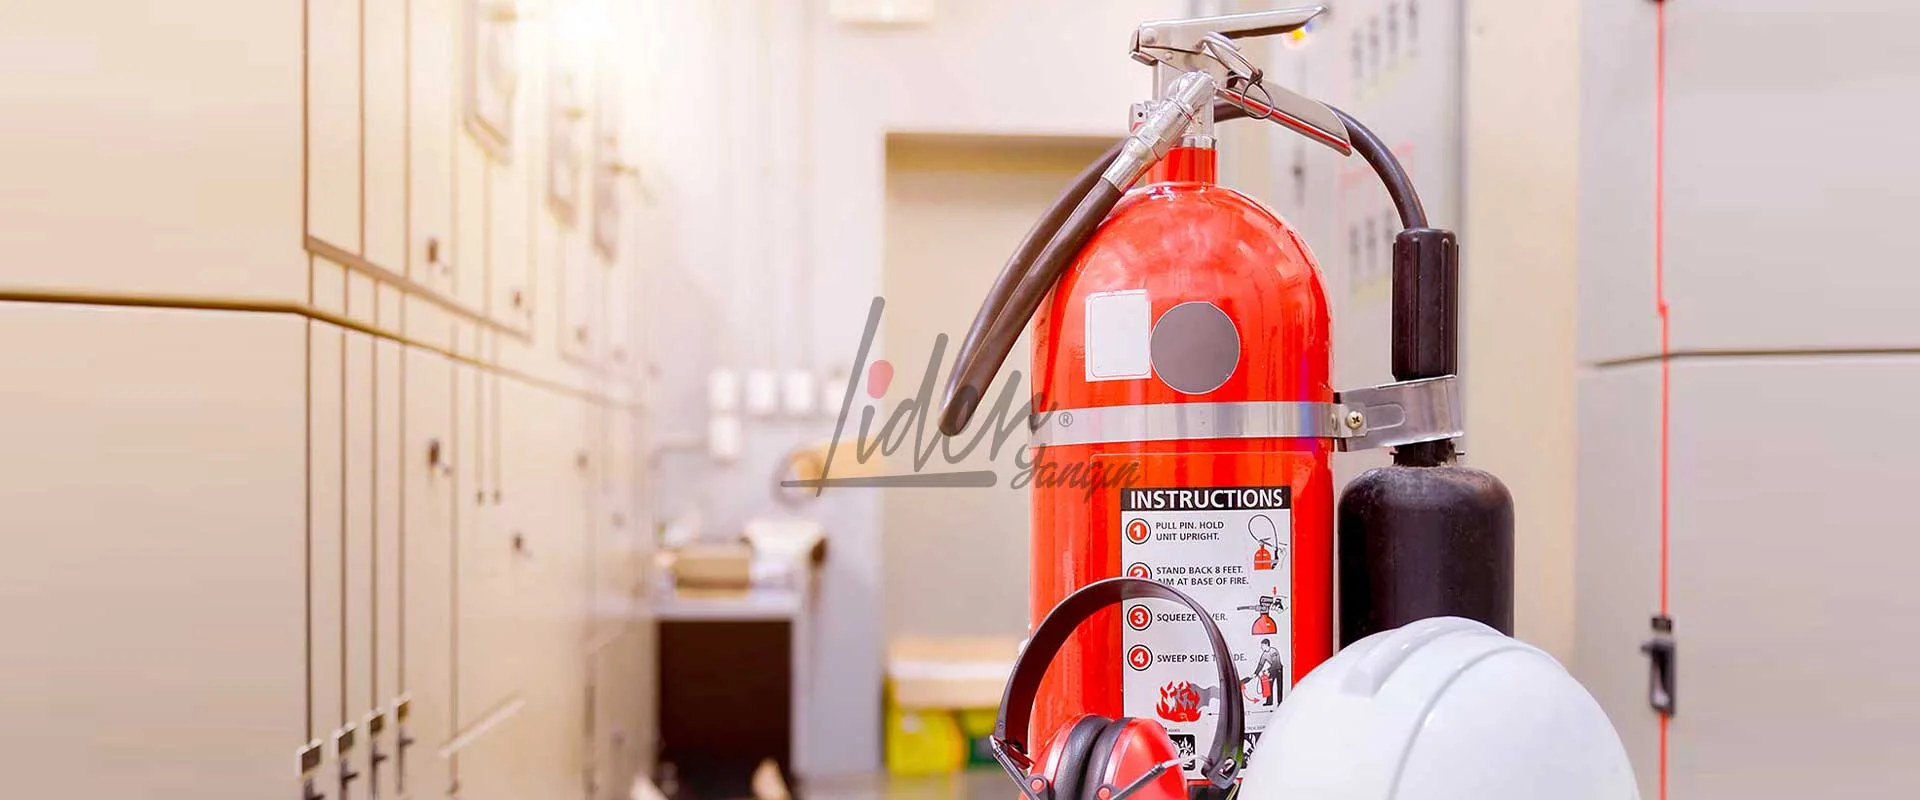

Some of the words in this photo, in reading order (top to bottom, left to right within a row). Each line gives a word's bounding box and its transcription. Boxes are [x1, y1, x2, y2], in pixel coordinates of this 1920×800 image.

[1130, 488, 1283, 509] INSTRUCTIONS
[1155, 521, 1178, 530] PULL
[1179, 521, 1197, 530] PIN.
[1199, 521, 1225, 530] HOLD
[1156, 533, 1177, 541] UNIT
[1179, 532, 1220, 541] UPRIGHT.
[1156, 566, 1186, 575] STAND
[1188, 566, 1213, 575] BACK
[1214, 566, 1221, 574] 8
[1222, 565, 1244, 574] FEET.
[1176, 577, 1189, 586] AT
[1191, 577, 1214, 586] BASE
[1215, 577, 1228, 586] OF
[1229, 576, 1249, 585] FIRE.
[1156, 613, 1197, 622] SQUEEZE
[1156, 654, 1188, 663] SWEEP
[1189, 654, 1209, 663] SIDE
